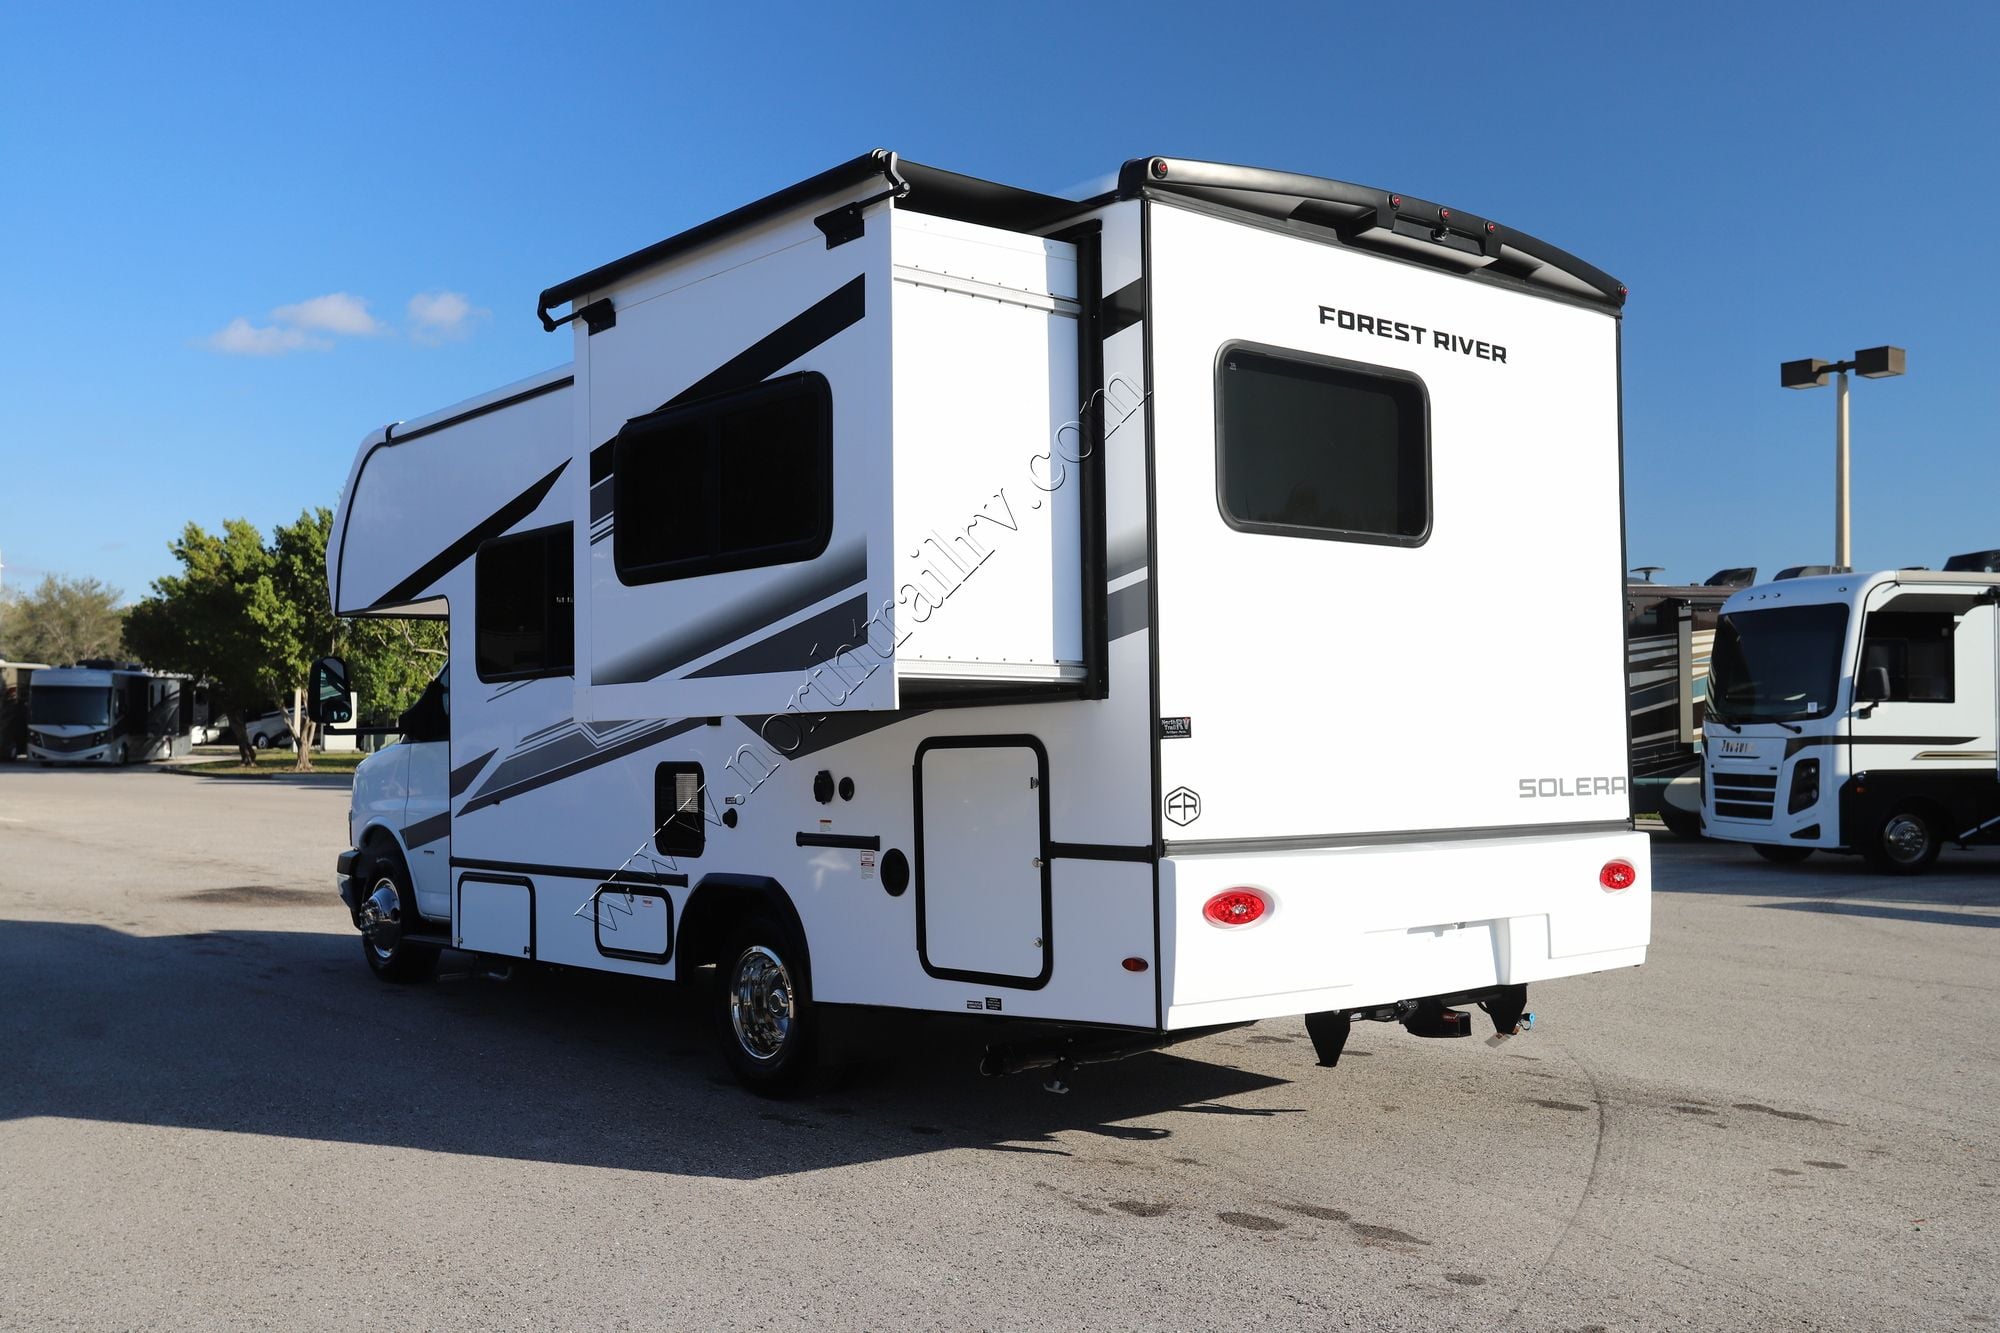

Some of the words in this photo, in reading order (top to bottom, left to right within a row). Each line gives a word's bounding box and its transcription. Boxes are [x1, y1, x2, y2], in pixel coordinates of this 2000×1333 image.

[1318, 305, 1427, 345] FOREST
[1433, 330, 1507, 364] RIVER
[1519, 776, 1627, 798] SOLERA
[1168, 792, 1197, 820] FR
